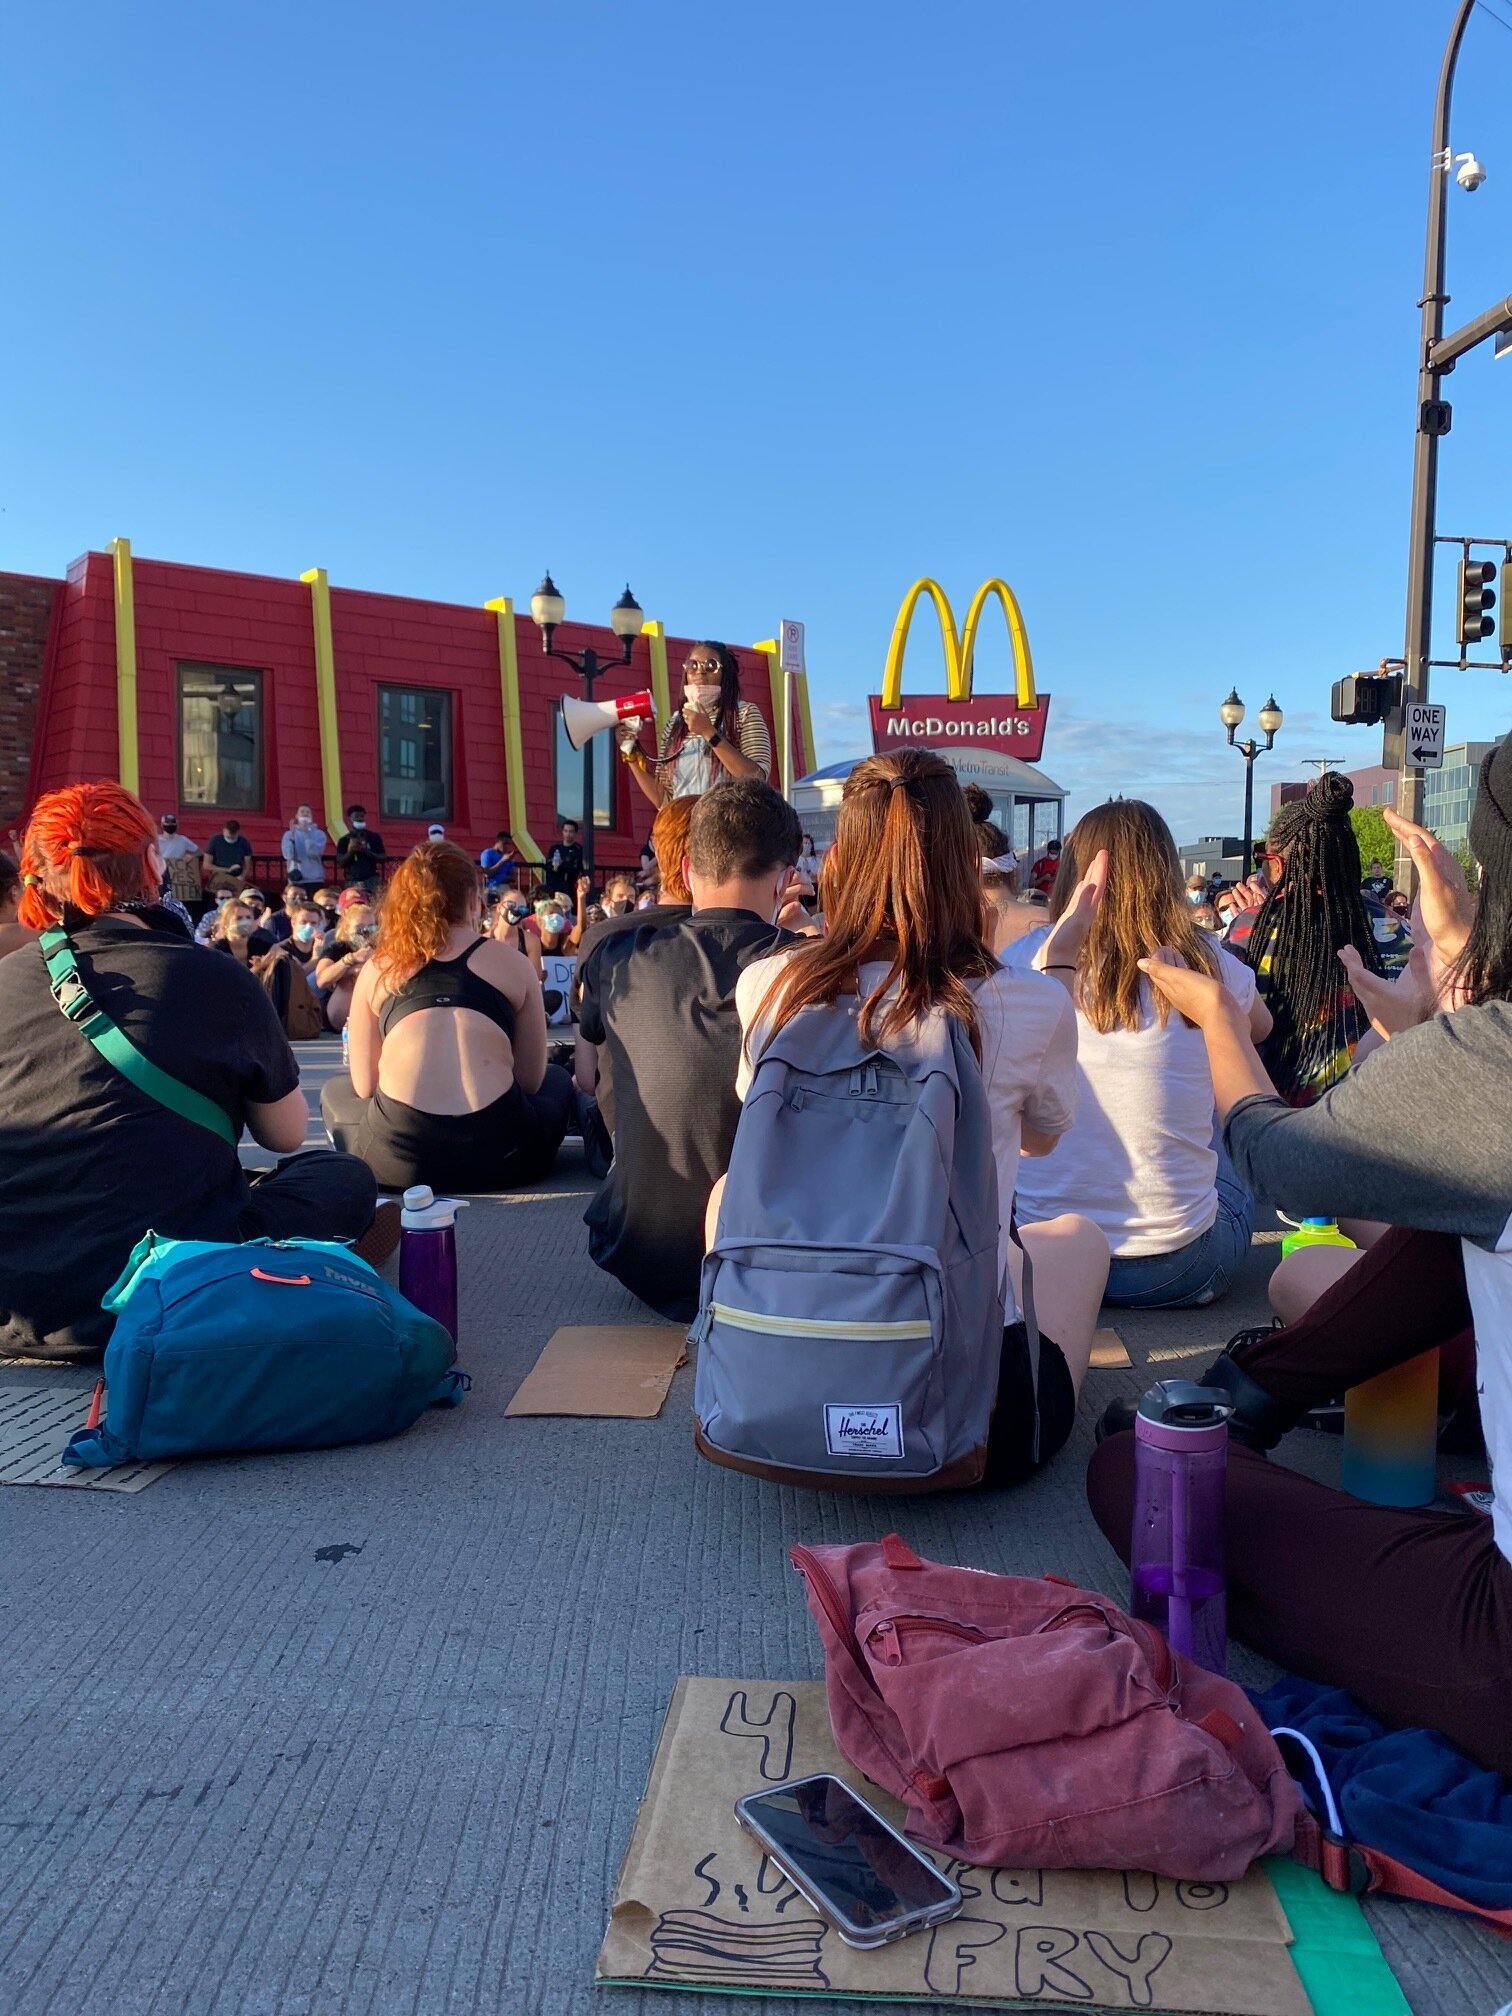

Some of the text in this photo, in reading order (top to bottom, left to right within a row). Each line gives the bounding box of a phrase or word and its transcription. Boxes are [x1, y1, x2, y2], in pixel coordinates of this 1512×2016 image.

[1412, 708, 1440, 724] ONE
[887, 717, 1031, 737] McDonald's
[1411, 726, 1440, 742] WAY
[167, 859, 194, 871] ACK
[838, 1416, 889, 1438] Herschel
[924, 1916, 1173, 2007] FRY
